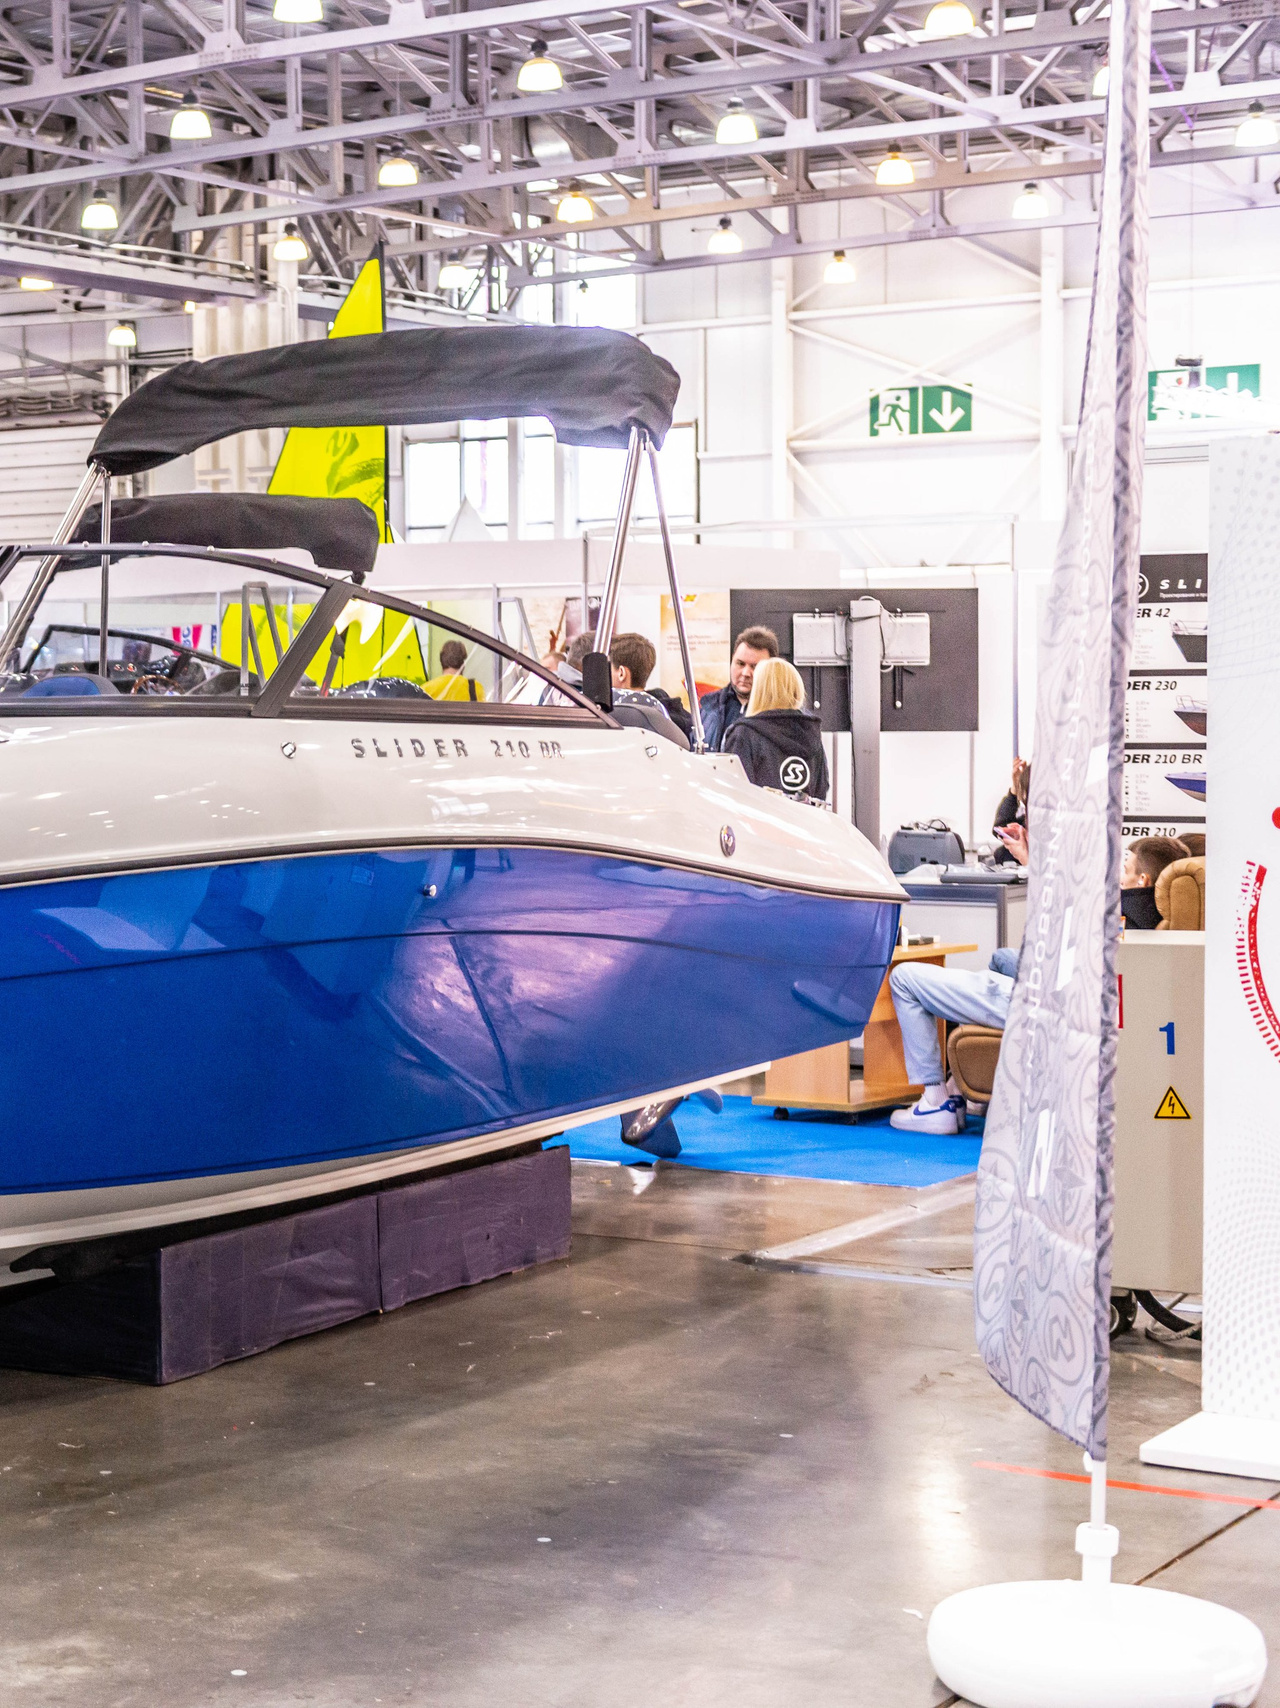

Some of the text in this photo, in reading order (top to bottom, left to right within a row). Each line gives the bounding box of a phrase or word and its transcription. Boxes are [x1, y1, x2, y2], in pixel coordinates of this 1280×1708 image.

[1159, 578, 1202, 590] SLI
[1155, 607, 1171, 618] 42
[1155, 680, 1177, 691] 230
[351, 738, 565, 759] SLIDER 210 BR
[1154, 753, 1177, 764] 210
[1181, 753, 1203, 764] BR
[1121, 826, 1177, 838] DER 210
[1158, 1021, 1175, 1055] 1
